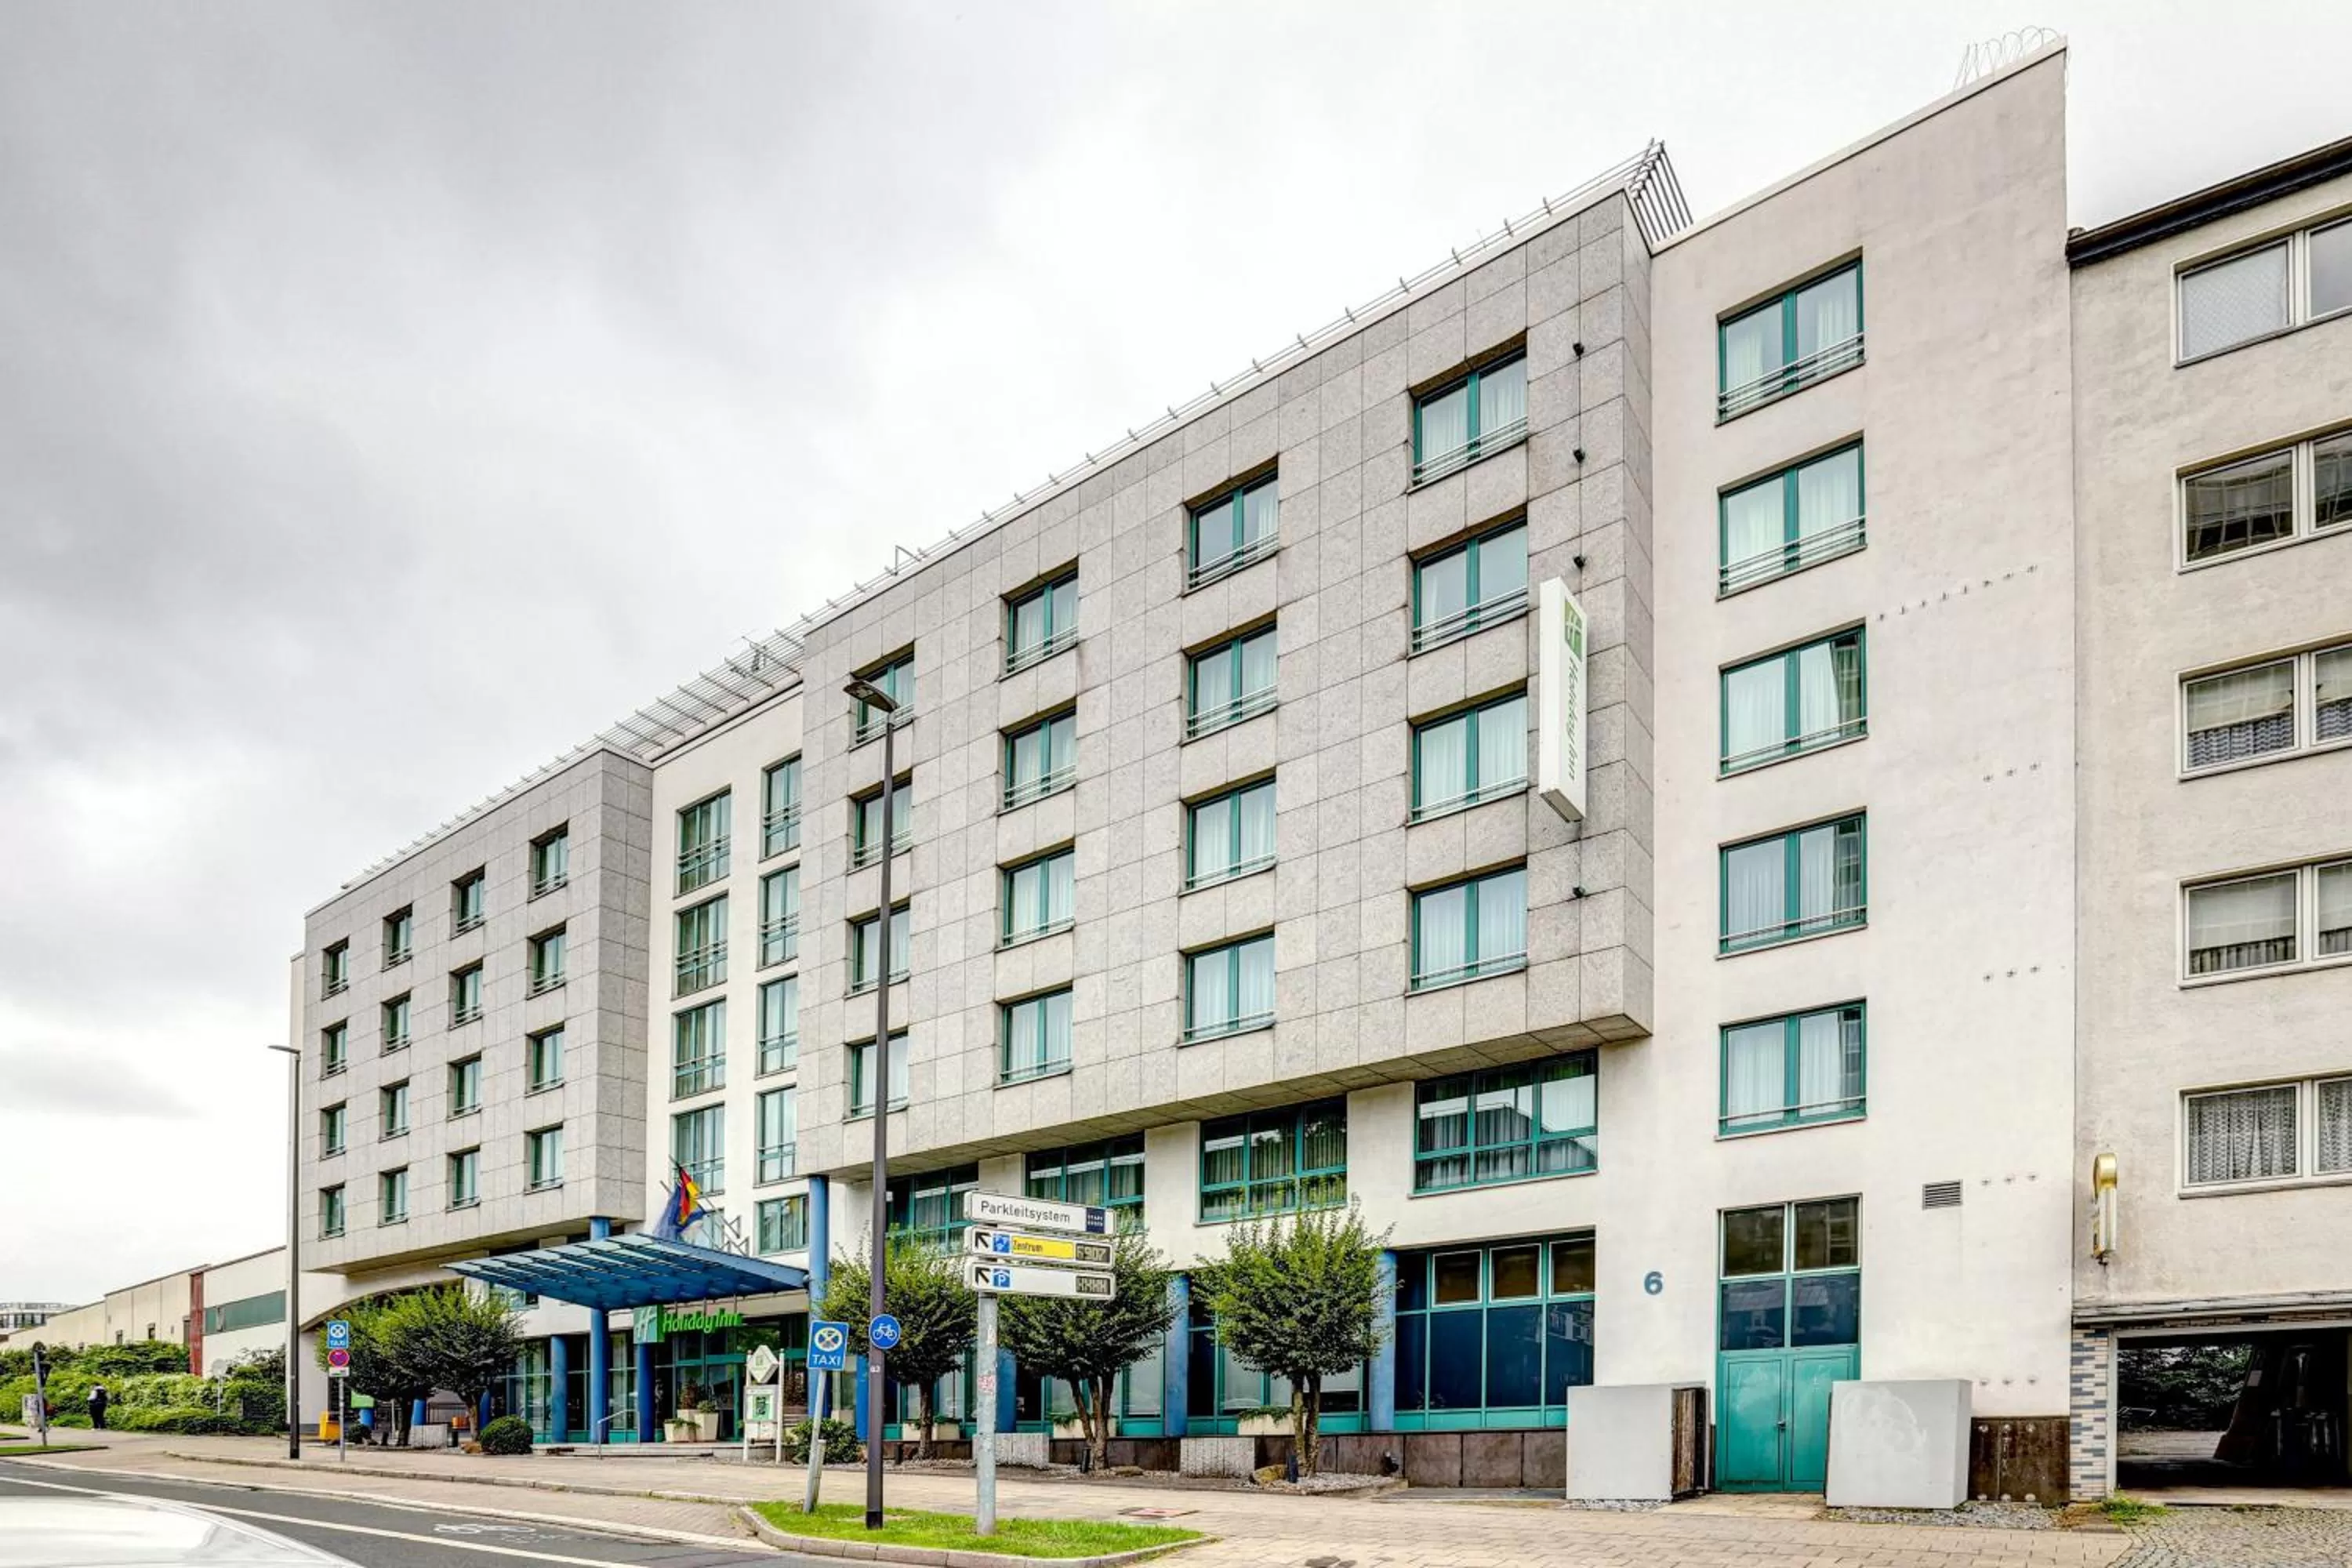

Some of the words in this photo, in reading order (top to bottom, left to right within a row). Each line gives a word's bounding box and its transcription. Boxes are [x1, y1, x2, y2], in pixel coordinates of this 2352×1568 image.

[980, 1200, 1071, 1224] Parkleitsystem
[1644, 1271, 1663, 1295] 6
[662, 1311, 713, 1333] Holiday
[811, 1354, 841, 1366] TAXI
